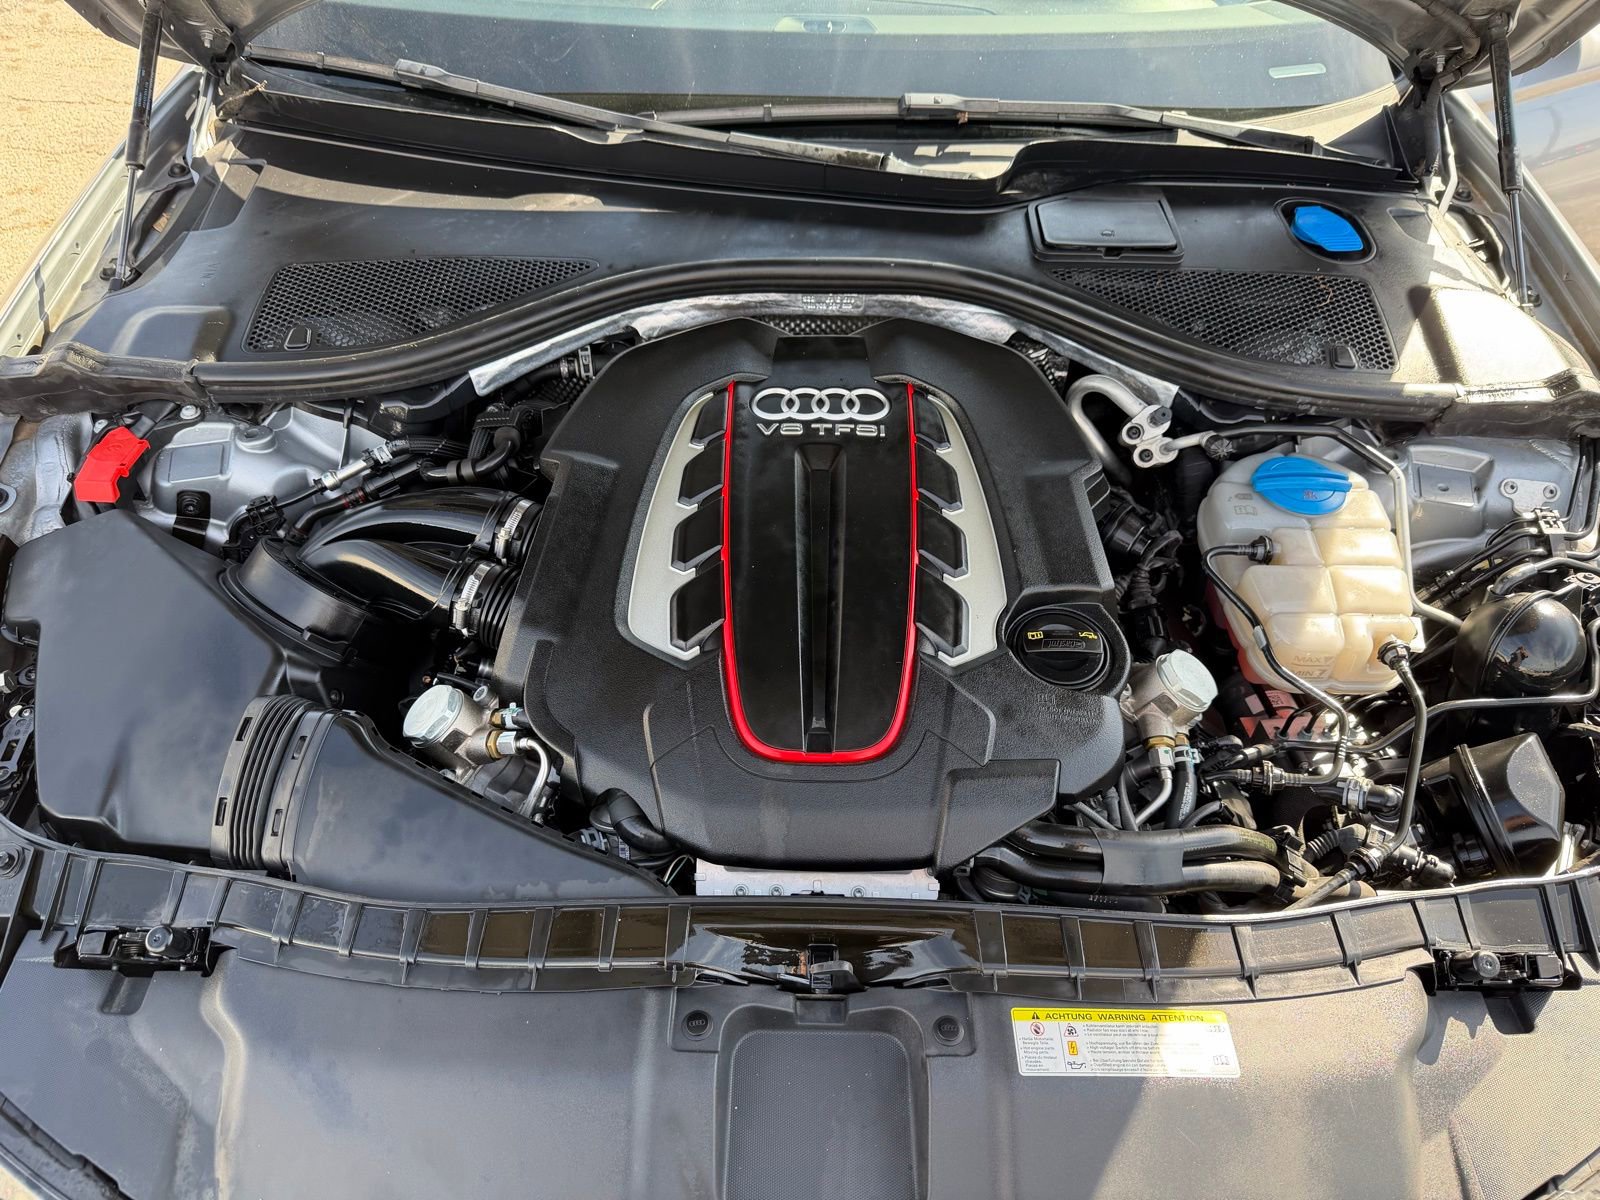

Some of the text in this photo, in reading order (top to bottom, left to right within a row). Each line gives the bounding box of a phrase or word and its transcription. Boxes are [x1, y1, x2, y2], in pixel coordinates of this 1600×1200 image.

[756, 423, 886, 437] V8 TFSI
[1293, 656, 1321, 664] MAX
[1045, 1012, 1204, 1022] ACHTUNG WARNING ATTENTION
